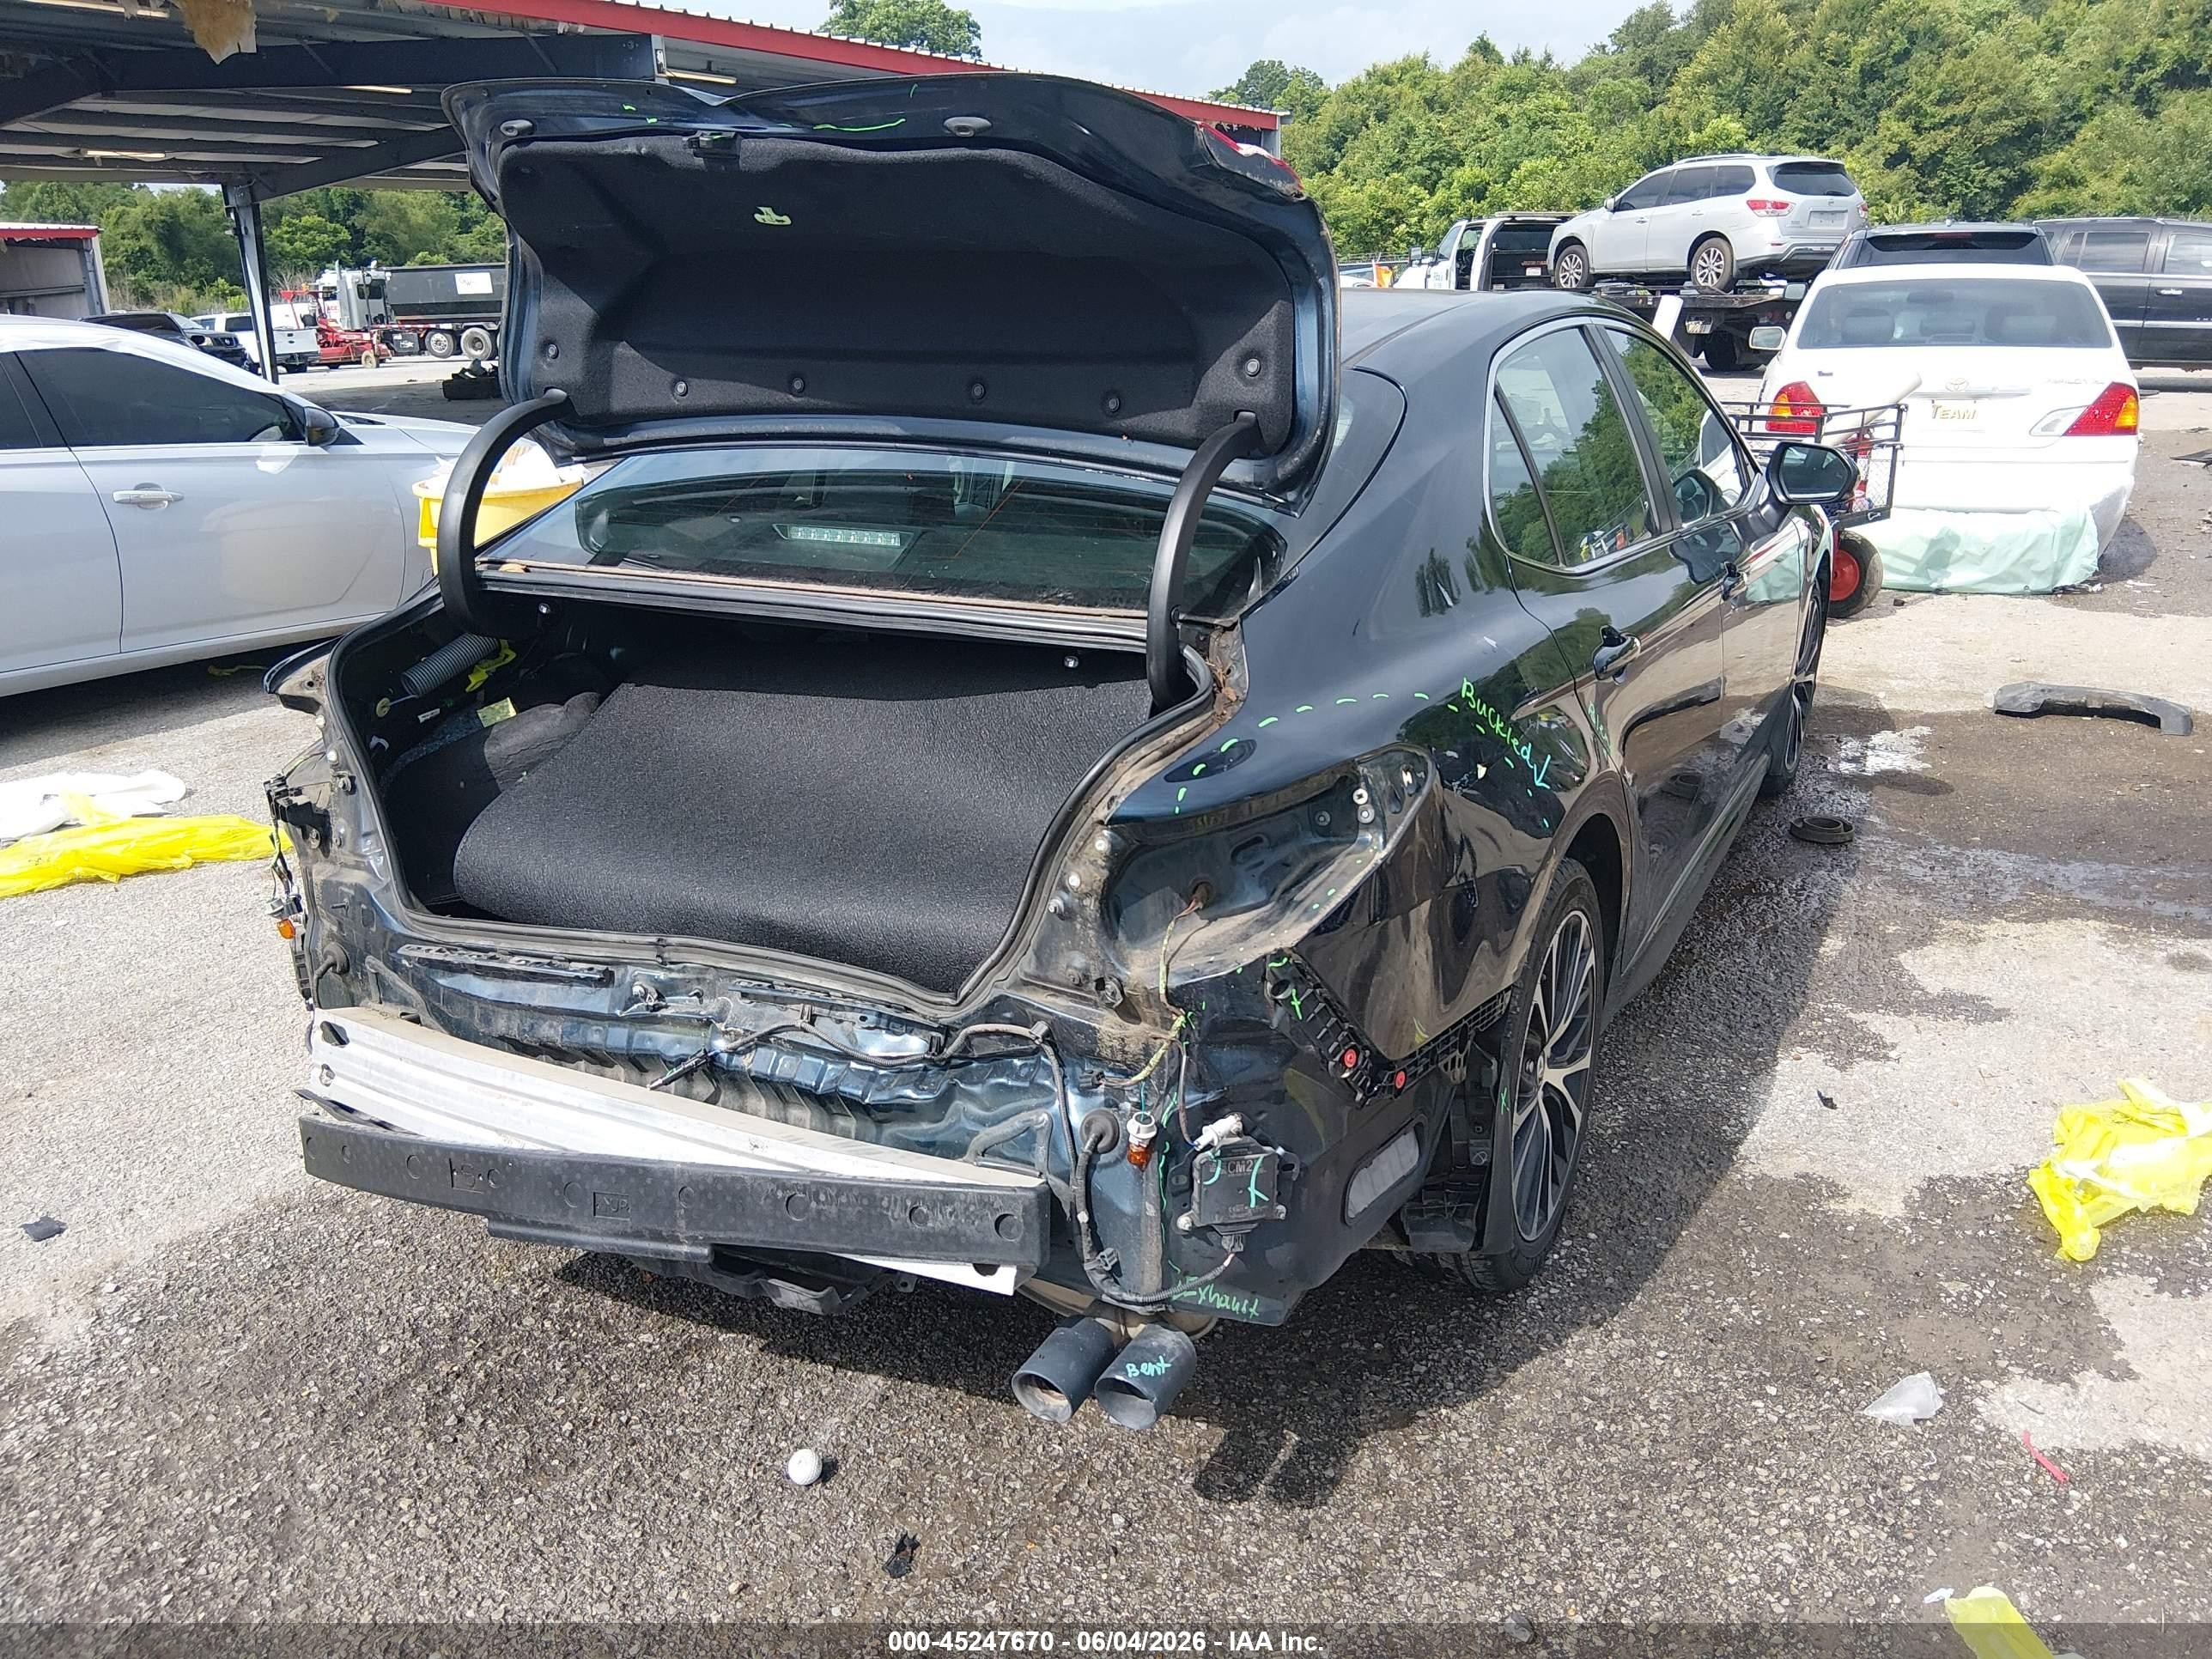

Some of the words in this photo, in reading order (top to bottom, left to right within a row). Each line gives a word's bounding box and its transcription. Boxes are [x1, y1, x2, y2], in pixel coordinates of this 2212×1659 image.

[1931, 404, 1979, 420] TEAM
[1461, 677, 1535, 769] Buckled
[1125, 1354, 1172, 1378] Bent
